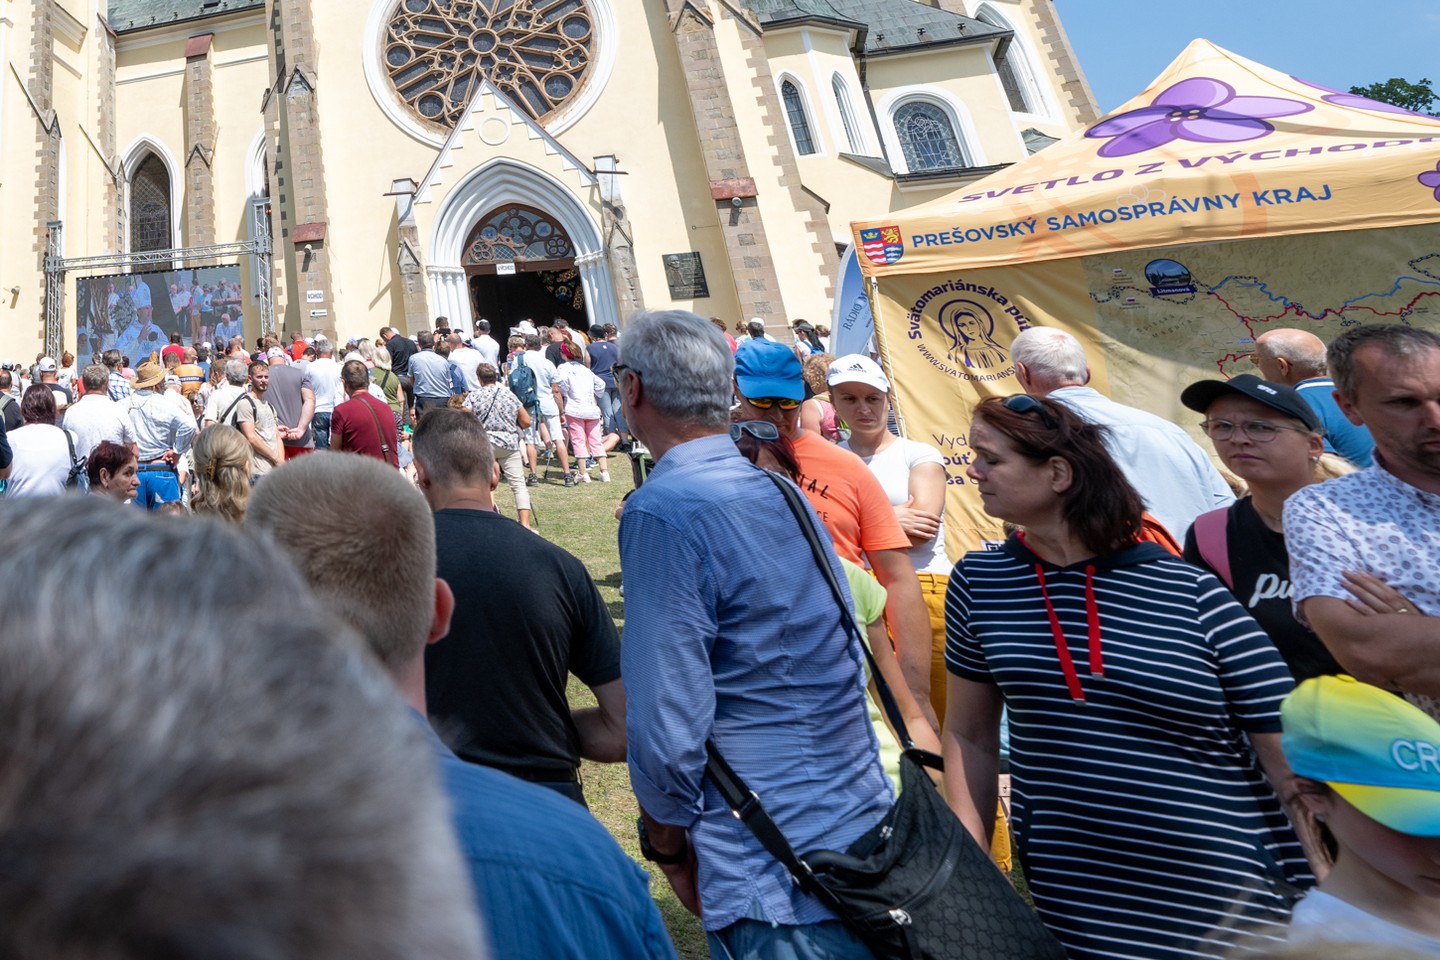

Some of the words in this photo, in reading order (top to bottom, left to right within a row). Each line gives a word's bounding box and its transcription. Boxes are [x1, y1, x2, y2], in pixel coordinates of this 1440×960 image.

[958, 168, 1124, 204] SVETLO
[1134, 161, 1166, 176] Z
[912, 217, 1037, 248] PREŠOVSKÝ
[1047, 192, 1241, 232] SAMOSPRÁVNY
[1252, 183, 1333, 208] KRAJ
[907, 278, 1009, 340] Svätomariánska
[917, 343, 1017, 382] WWW.SVATOMARIANS
[932, 433, 968, 450] Vyd
[1392, 739, 1440, 774] CR
